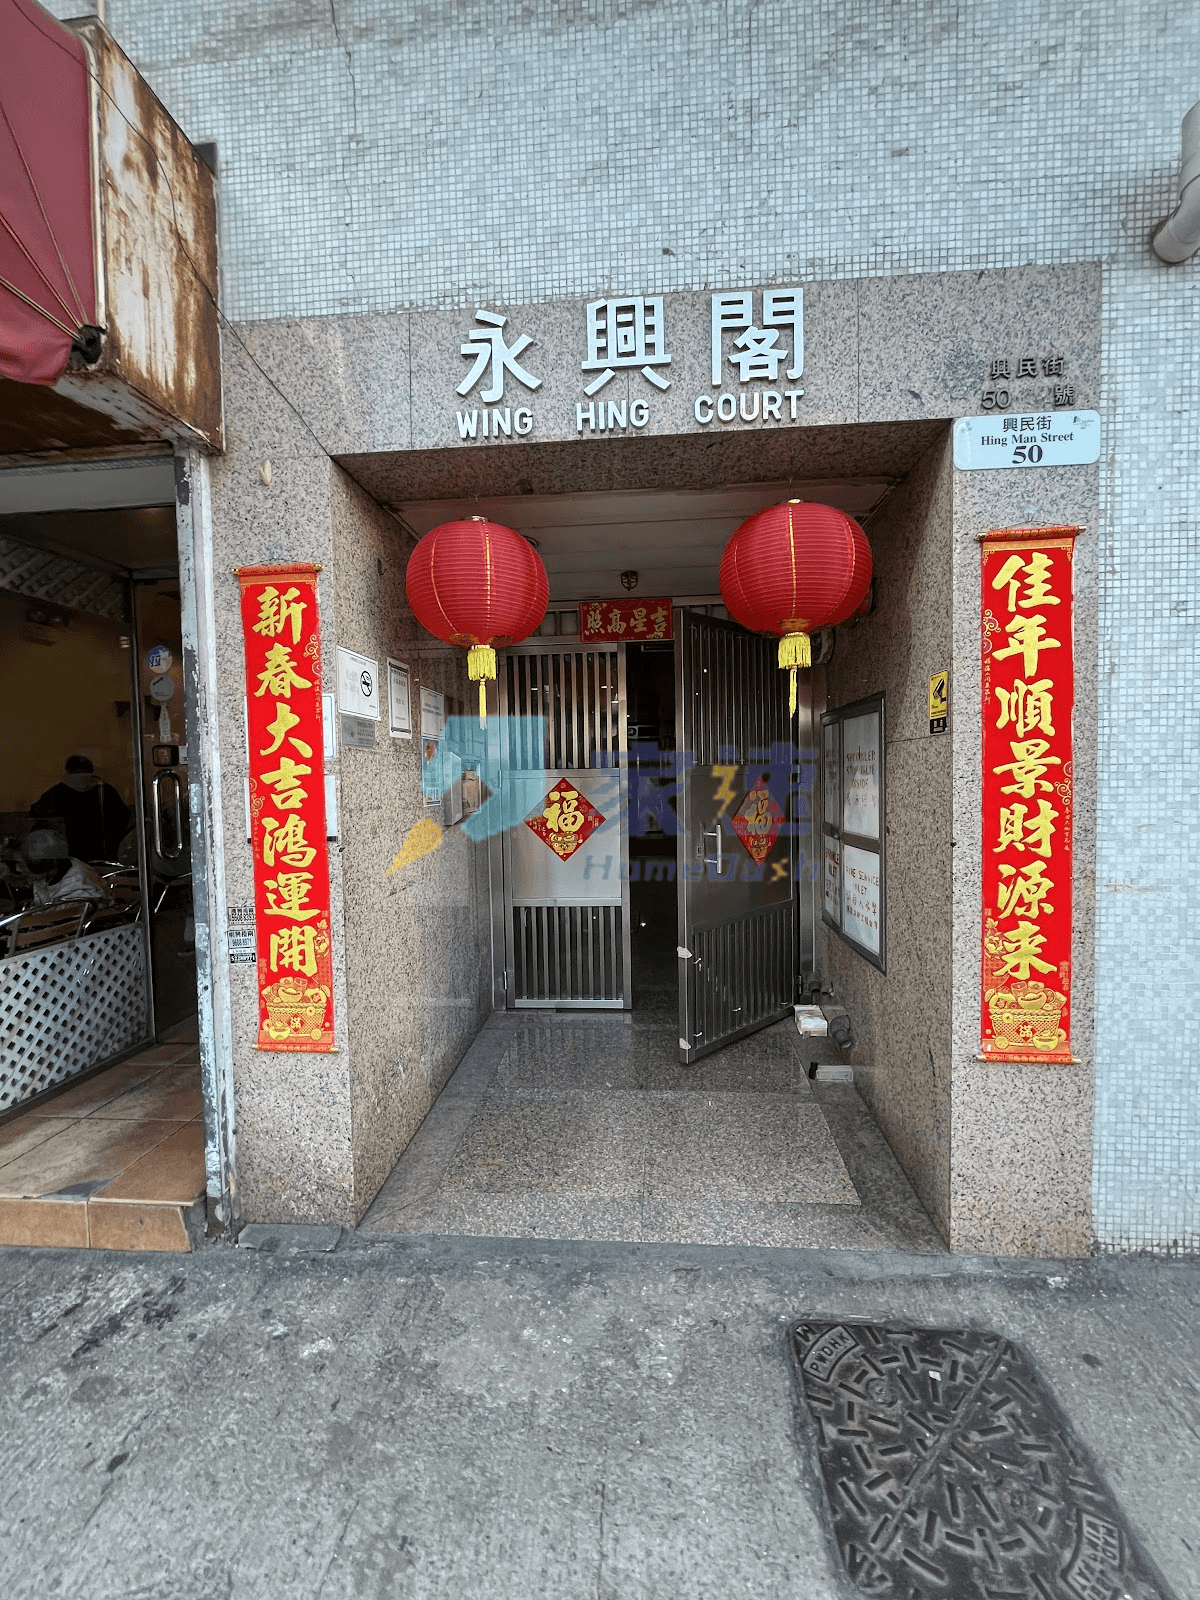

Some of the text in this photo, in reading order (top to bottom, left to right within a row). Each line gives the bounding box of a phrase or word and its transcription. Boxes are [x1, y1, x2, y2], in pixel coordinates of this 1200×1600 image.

[455, 287, 804, 404] 永興閣
[990, 357, 1065, 380] 興民街
[455, 389, 805, 439] WING HING COURT
[981, 384, 1075, 410] 50 號
[980, 431, 1075, 447] Hing Man Street
[1002, 415, 1052, 433] 興民街
[1011, 444, 1044, 464] 50
[252, 586, 321, 977] 新春大吉鴻運開
[543, 788, 585, 833] 福
[744, 789, 773, 836] 福
